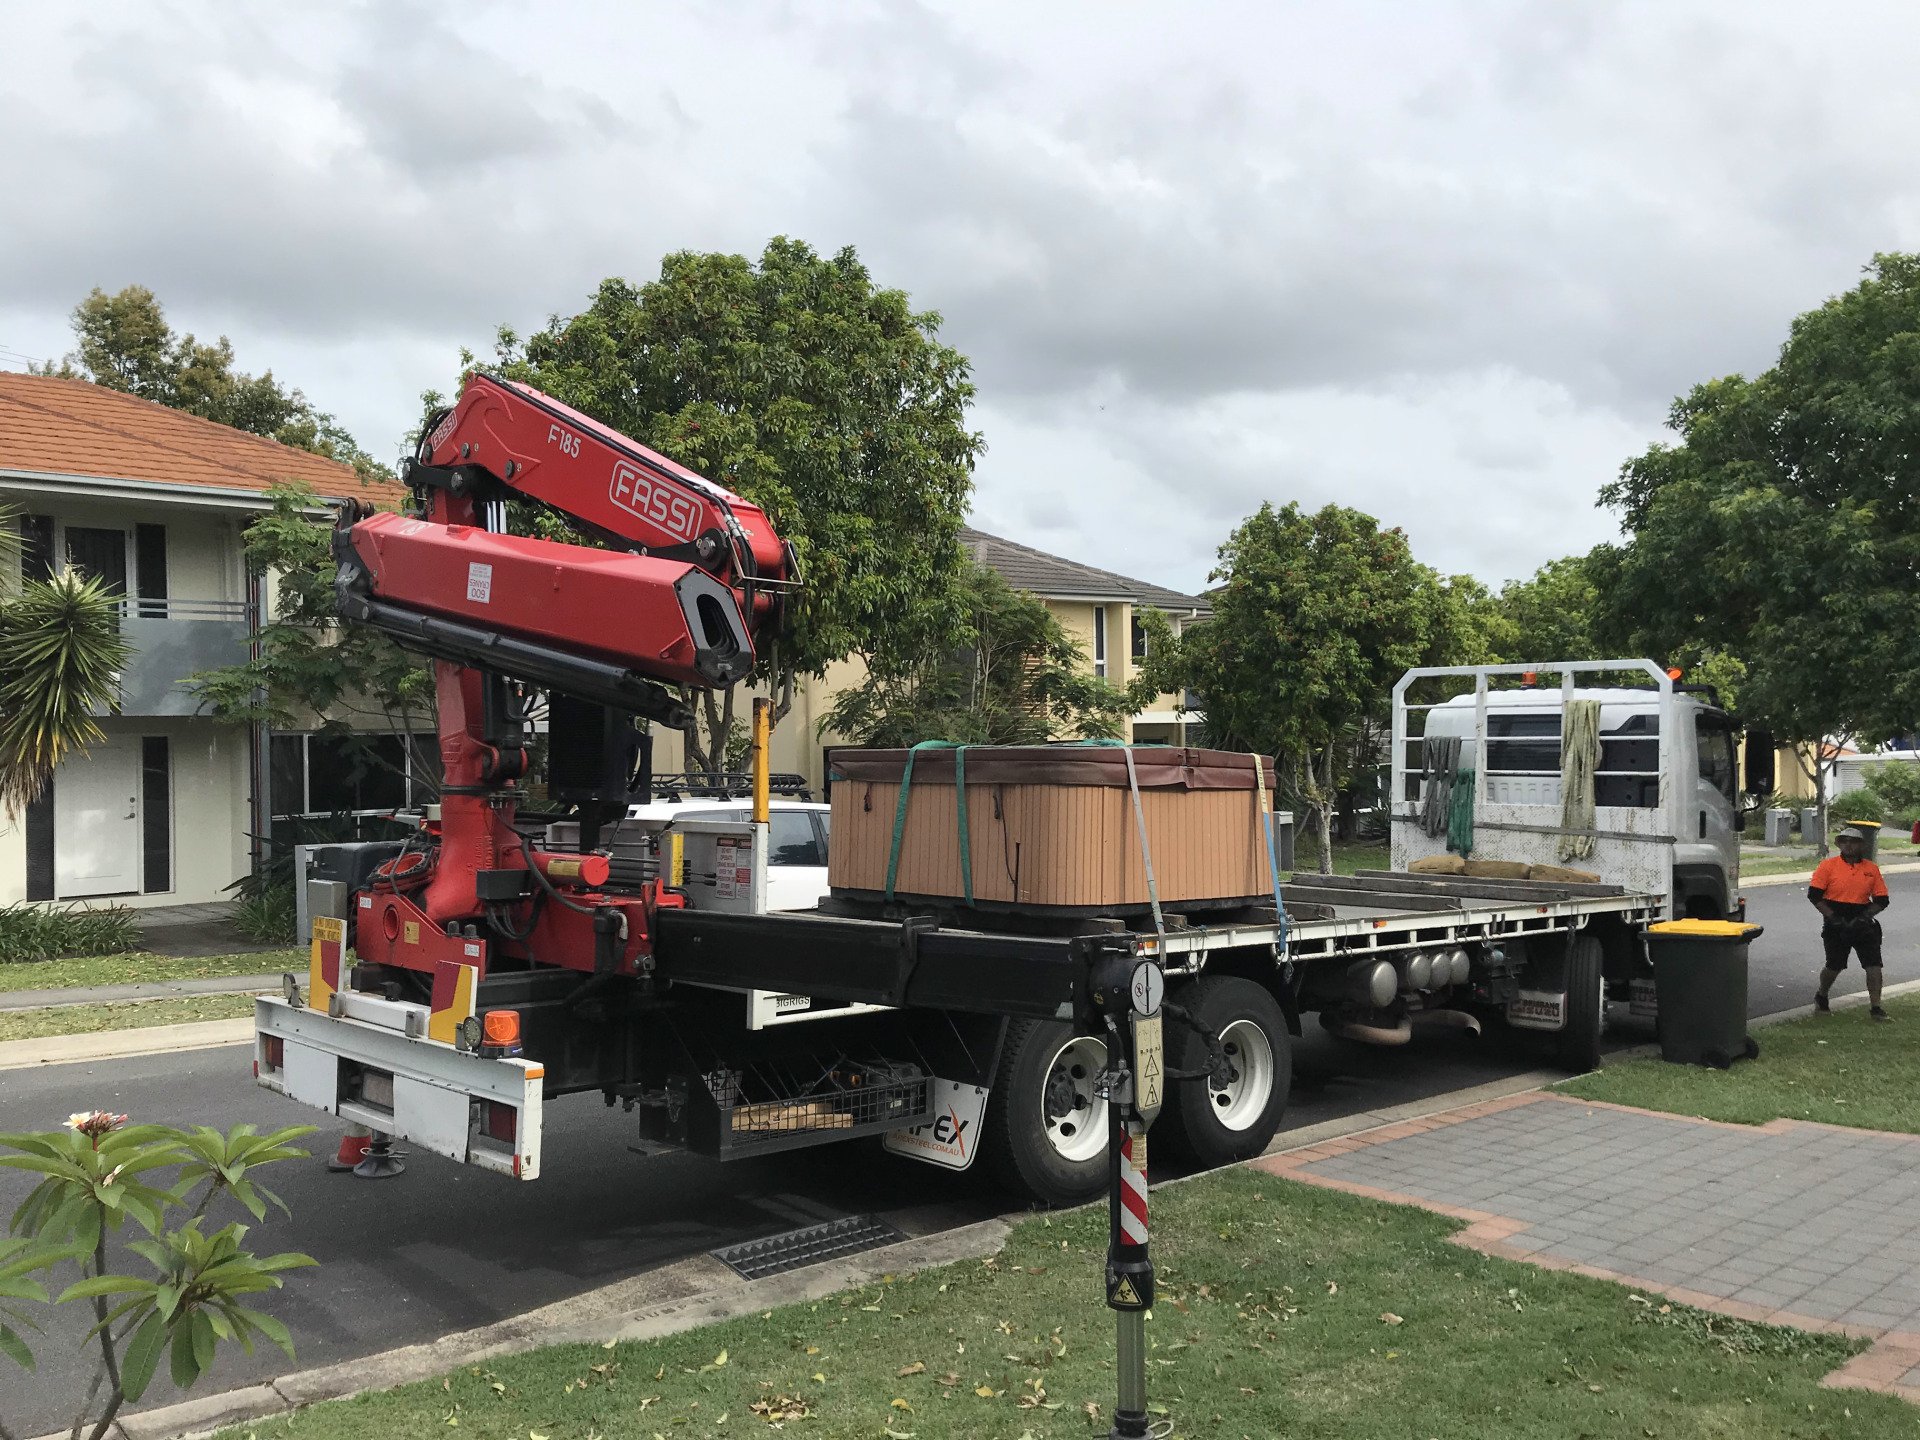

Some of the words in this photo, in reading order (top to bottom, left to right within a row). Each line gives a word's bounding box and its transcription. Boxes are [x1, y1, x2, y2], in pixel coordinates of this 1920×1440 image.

[432, 413, 457, 448] FASSI
[547, 424, 582, 459] F185
[615, 468, 697, 538] FASSI
[471, 588, 486, 599] 600
